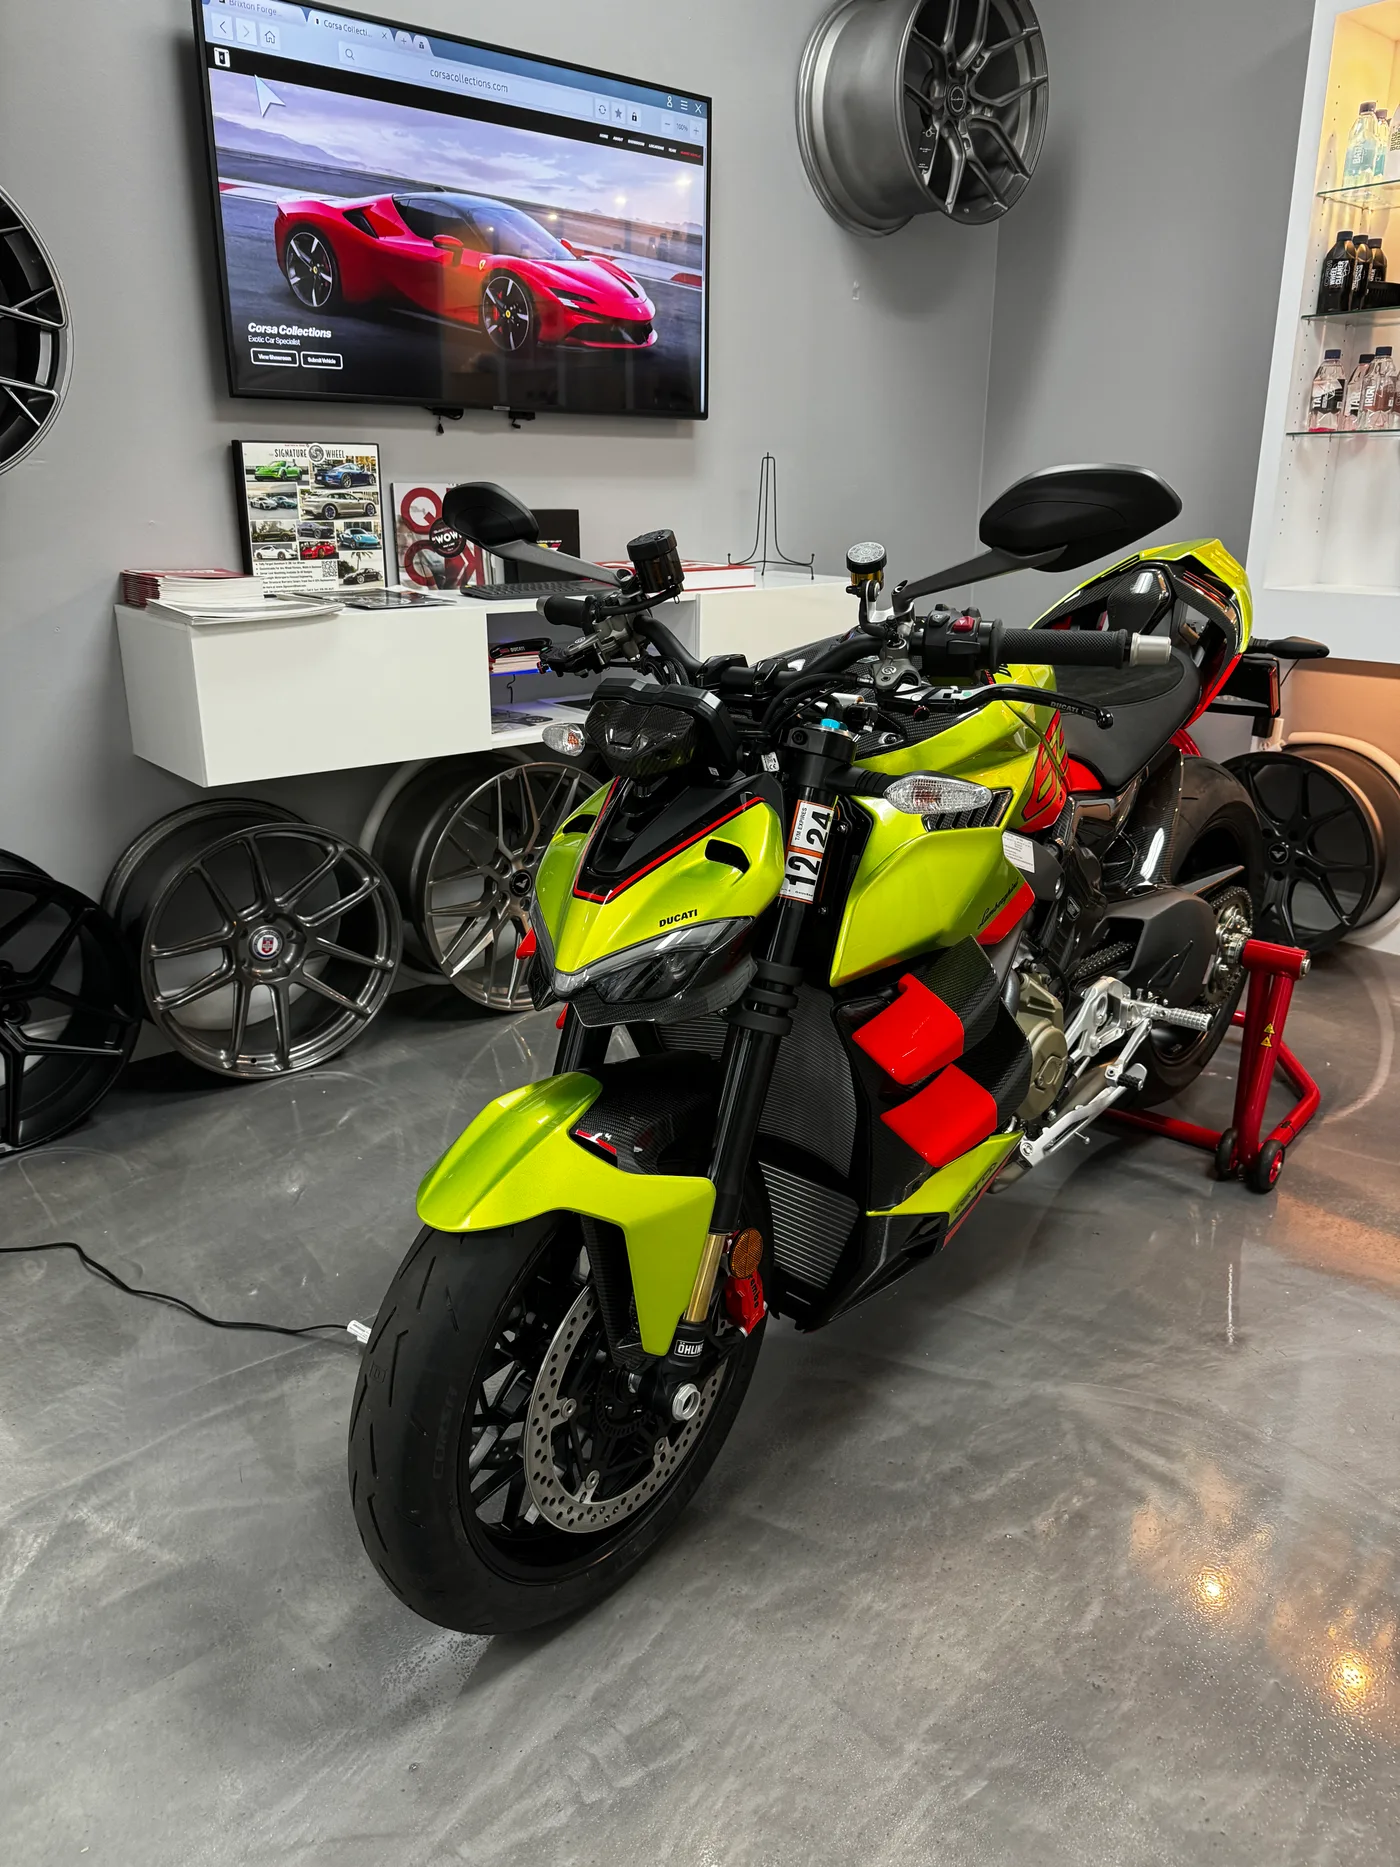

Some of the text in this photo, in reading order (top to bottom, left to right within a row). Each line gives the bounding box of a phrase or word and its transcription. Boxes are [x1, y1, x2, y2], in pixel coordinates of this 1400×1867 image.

[323, 19, 342, 31] Corsa
[429, 67, 509, 94] corsacollections.com
[248, 322, 332, 338] Corsa Collections
[248, 335, 301, 346] Exotic Car Specialist
[274, 448, 345, 459] SIGNATURE WHEEL
[1050, 701, 1079, 713] DUCATI
[797, 807, 808, 831] EXPIRES
[806, 810, 832, 849] 24
[784, 855, 821, 886] 12
[977, 876, 1019, 930] Lamborghini
[659, 908, 698, 928] DUCATI
